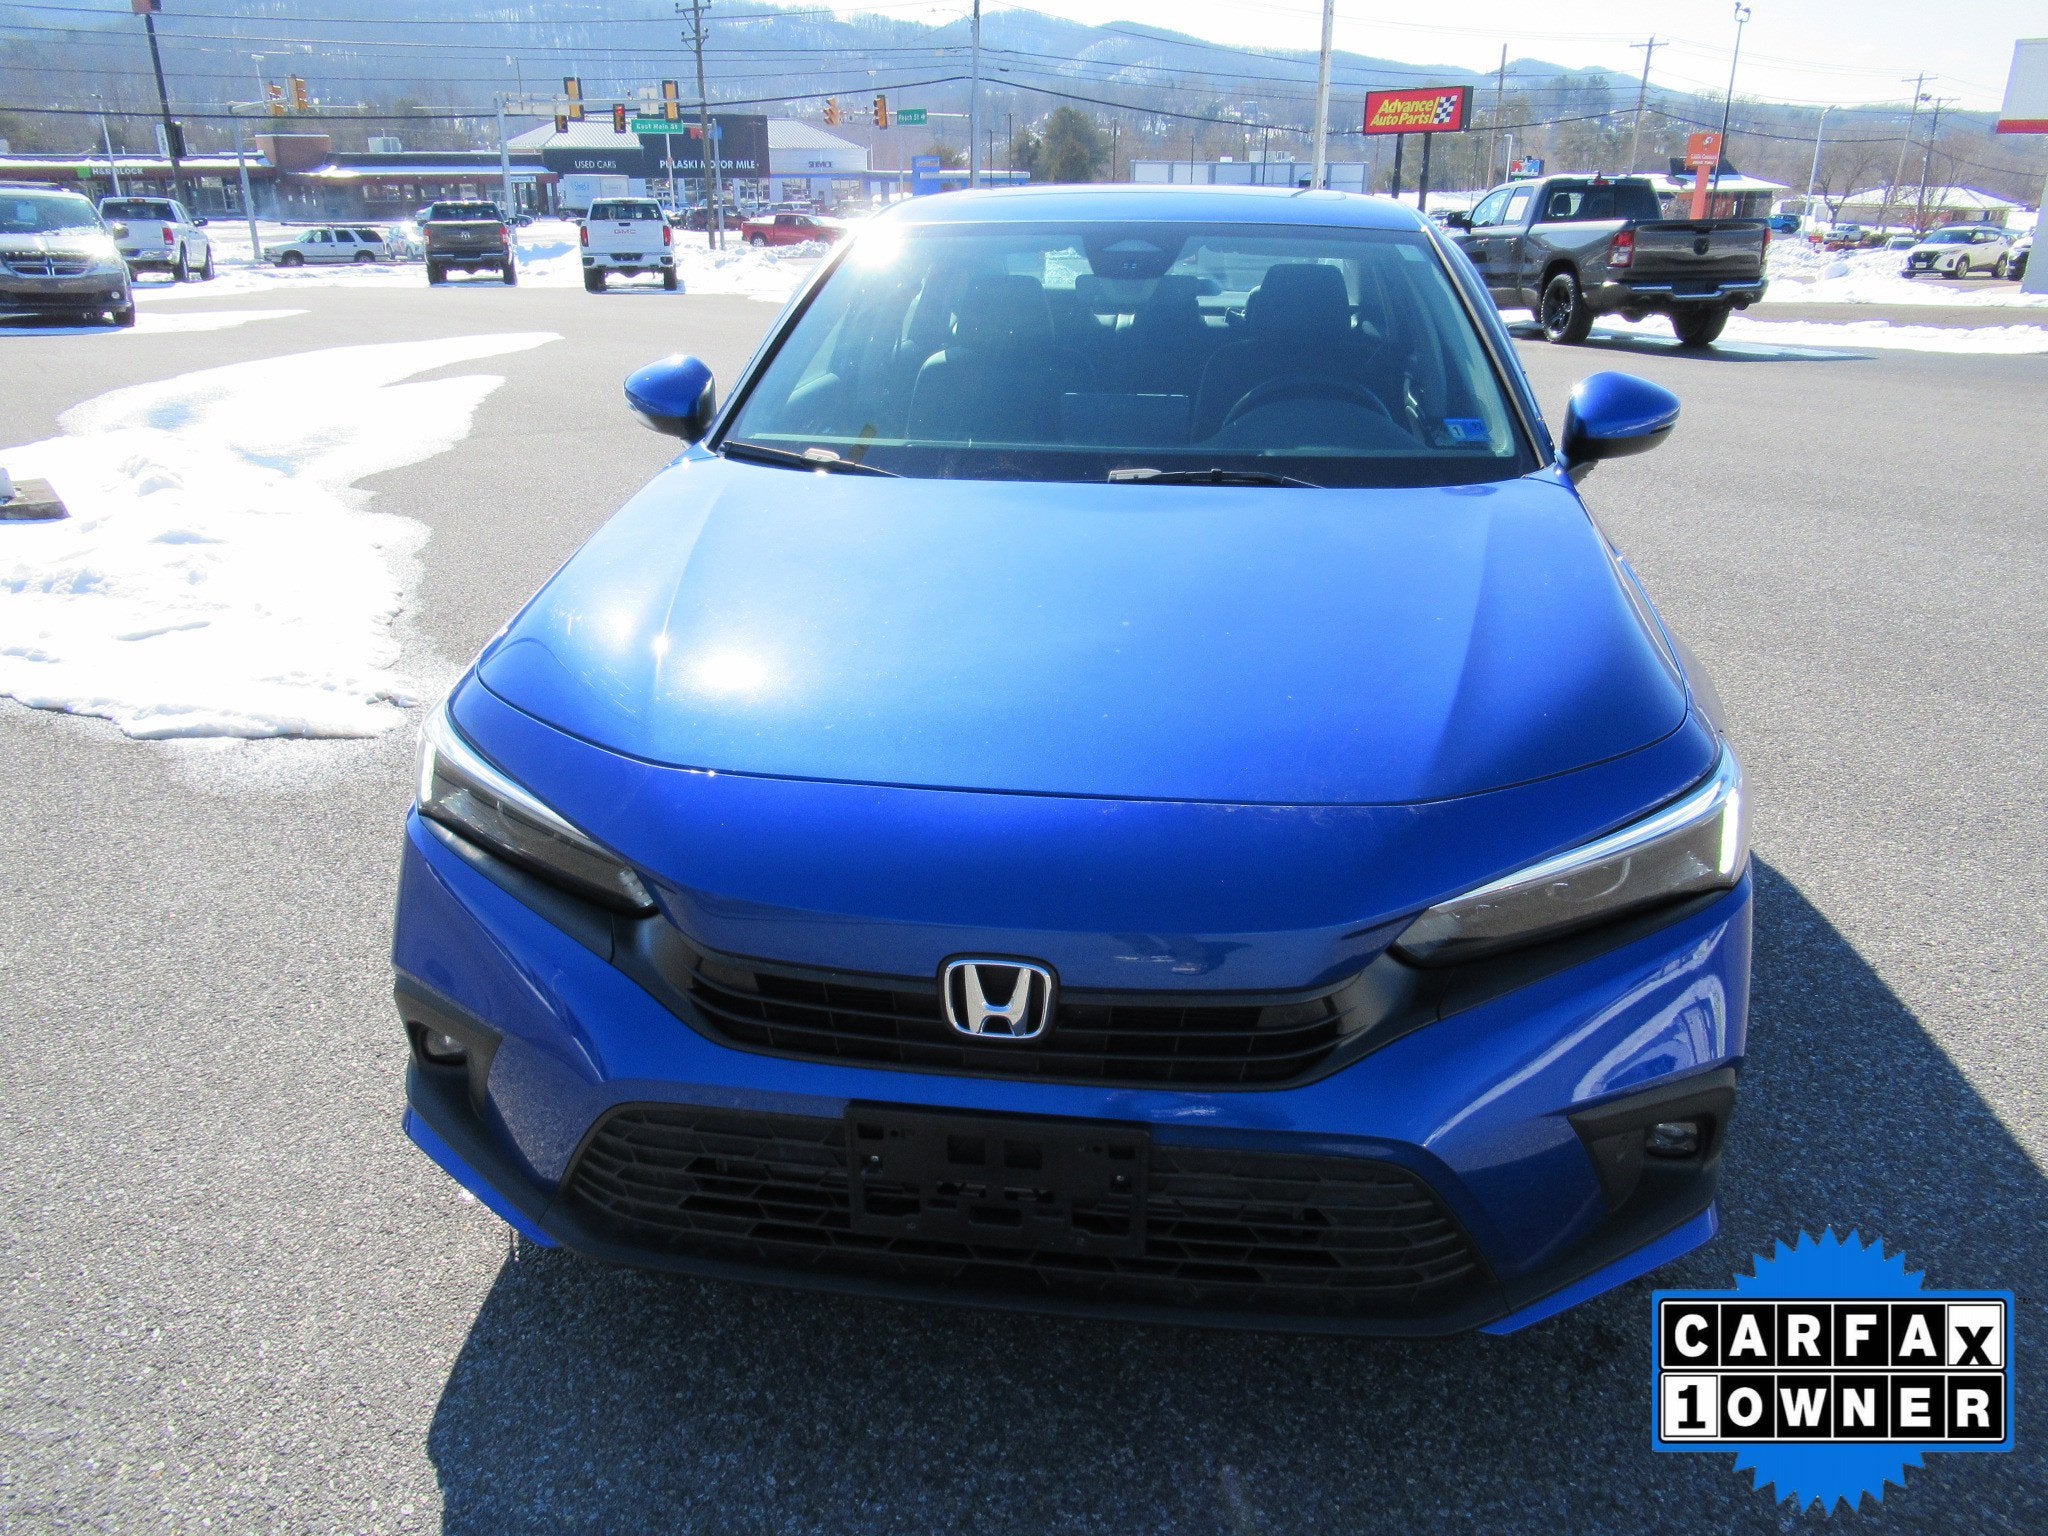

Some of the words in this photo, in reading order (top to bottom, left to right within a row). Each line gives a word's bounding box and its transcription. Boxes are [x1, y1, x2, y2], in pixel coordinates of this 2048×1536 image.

[1378, 98, 1433, 113] Advance
[1370, 113, 1400, 126] Auto
[1399, 112, 1431, 124] Parts
[574, 160, 595, 169] USED
[596, 160, 617, 169] CARS
[735, 159, 756, 169] MILE
